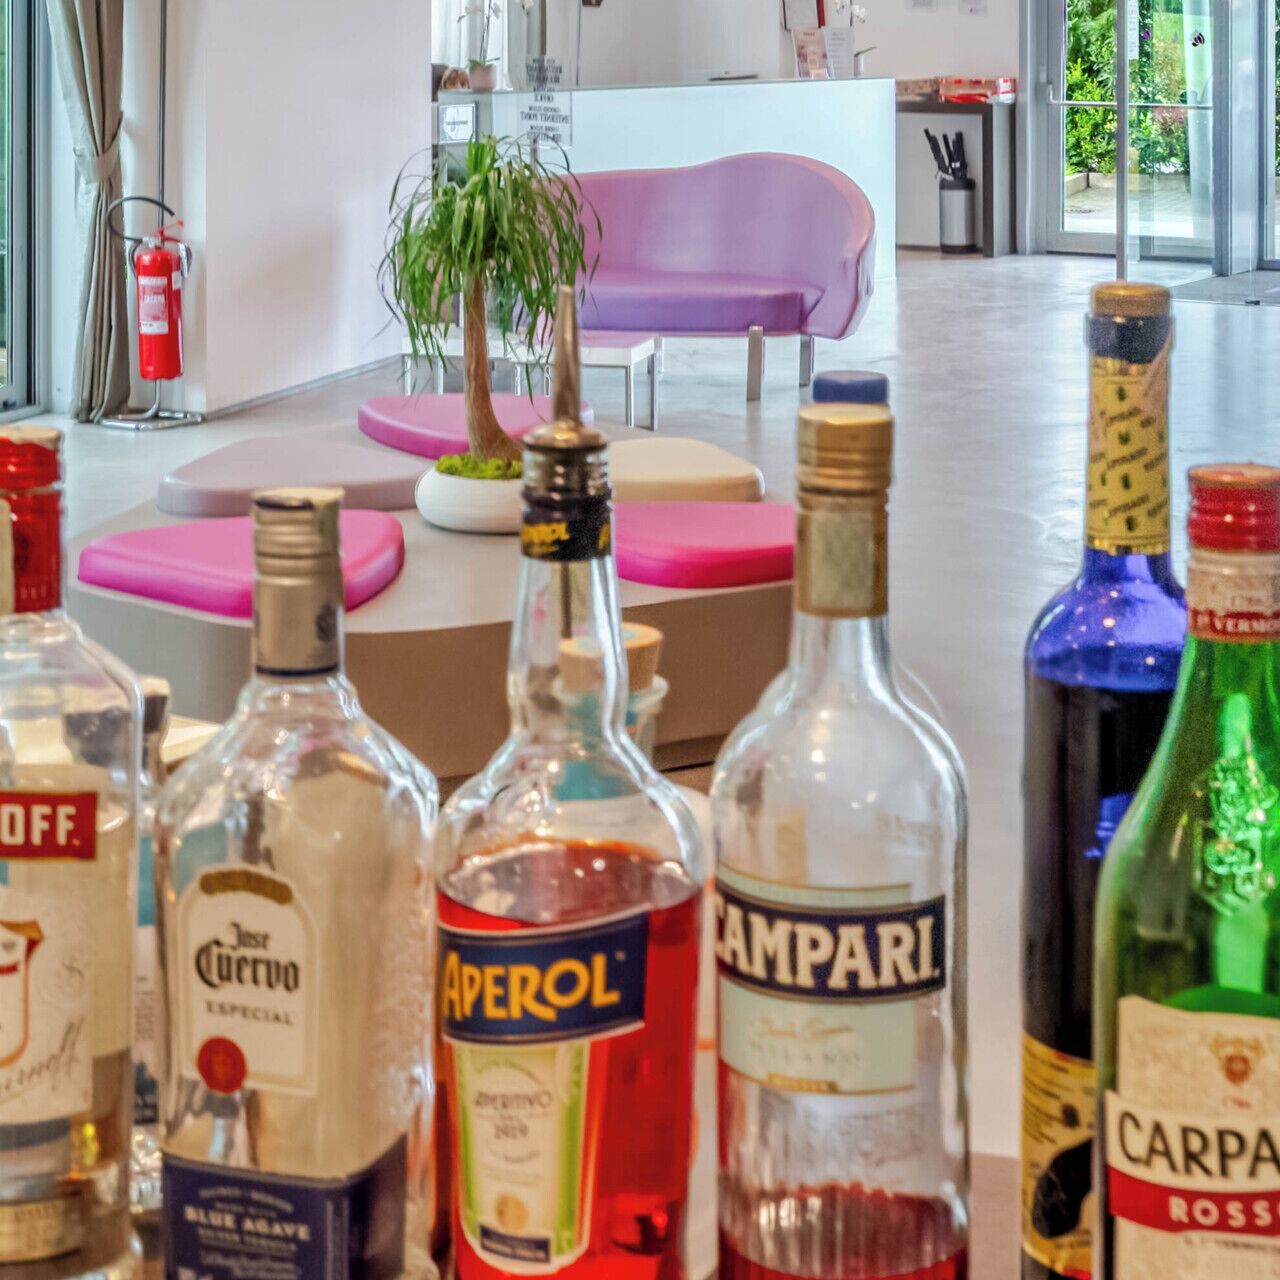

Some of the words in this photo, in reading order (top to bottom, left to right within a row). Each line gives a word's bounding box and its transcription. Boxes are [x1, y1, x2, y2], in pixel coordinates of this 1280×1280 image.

[195, 937, 300, 993] Cuervo
[716, 892, 936, 990] CAMPARI
[205, 999, 293, 1026] ESPECIAL
[444, 950, 621, 1022] APEROL
[183, 1204, 237, 1230] BLUE
[241, 1217, 311, 1242] AGAVE
